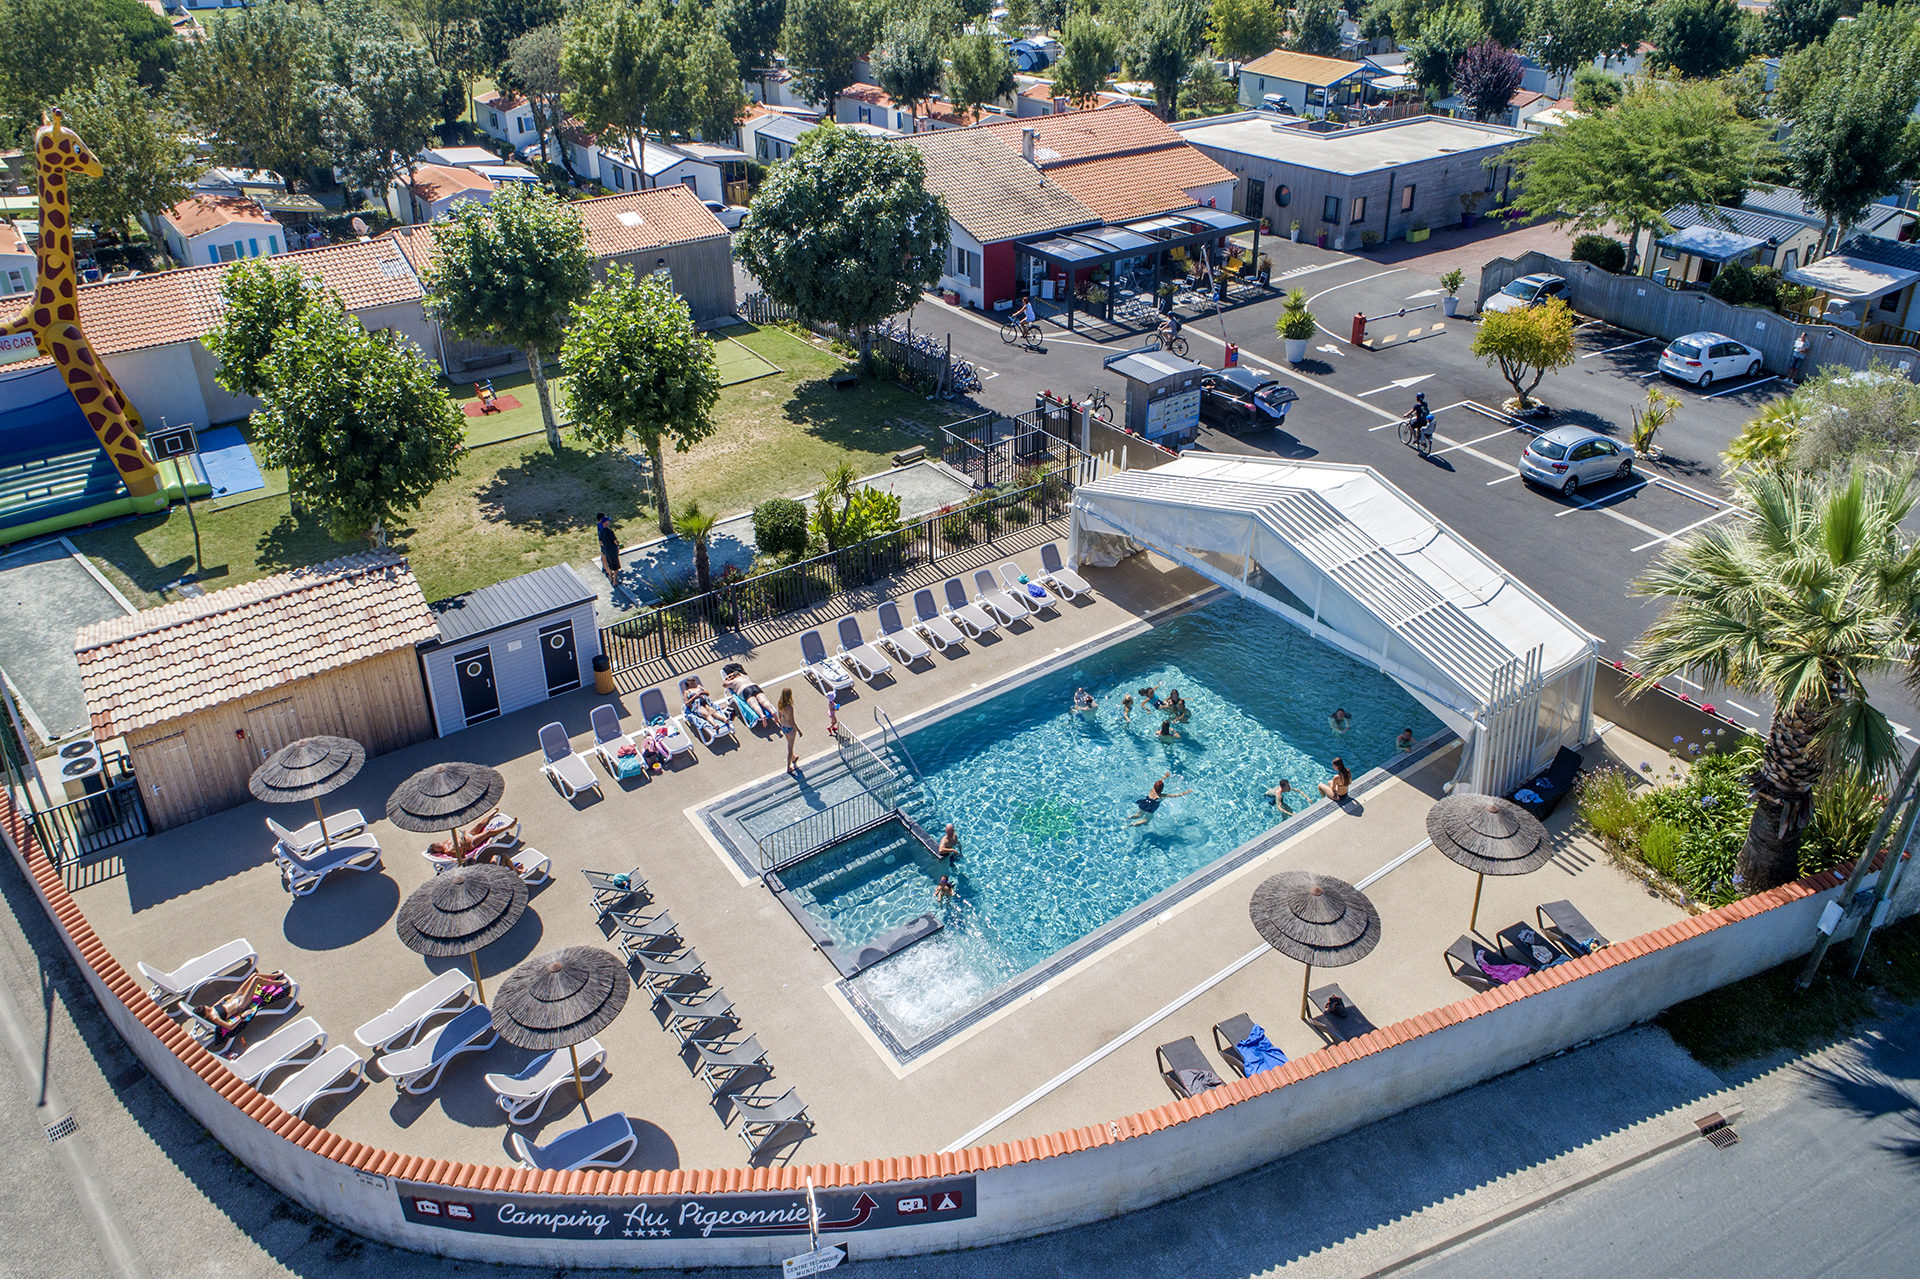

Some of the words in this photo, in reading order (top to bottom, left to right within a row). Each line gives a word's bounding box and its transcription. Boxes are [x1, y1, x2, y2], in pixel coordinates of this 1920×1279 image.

[13, 336, 34, 349] CAR
[497, 1203, 610, 1235] Camping
[623, 1202, 669, 1227] Au
[786, 1263, 808, 1274] CENTRE
[809, 1254, 839, 1267] TECHNIQUE
[796, 1262, 831, 1277] MUNICIPAL
